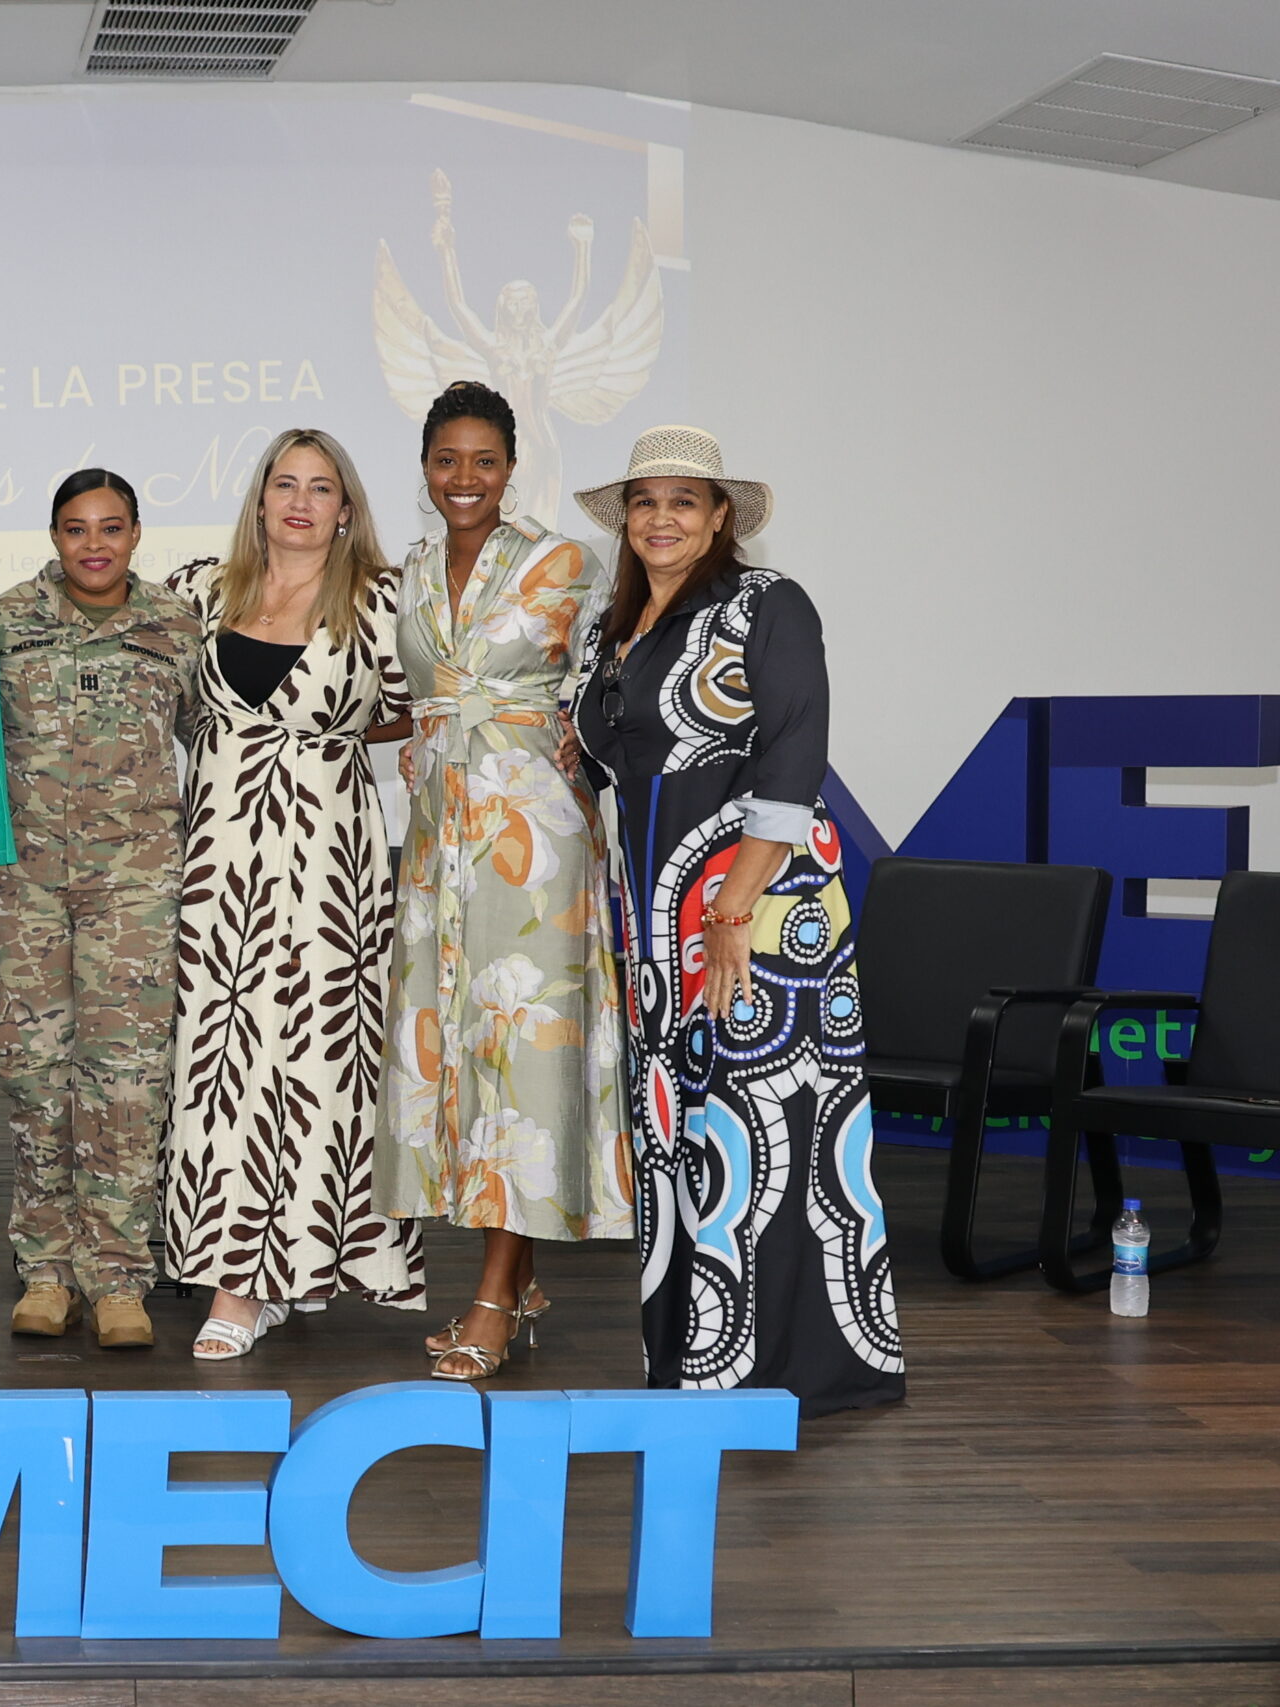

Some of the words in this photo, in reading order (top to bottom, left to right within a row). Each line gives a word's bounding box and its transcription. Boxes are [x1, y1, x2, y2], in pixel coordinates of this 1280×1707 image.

[32, 365, 95, 409] LA
[117, 359, 325, 406] PRESEA
[120, 642, 177, 666] AERONAVAL
